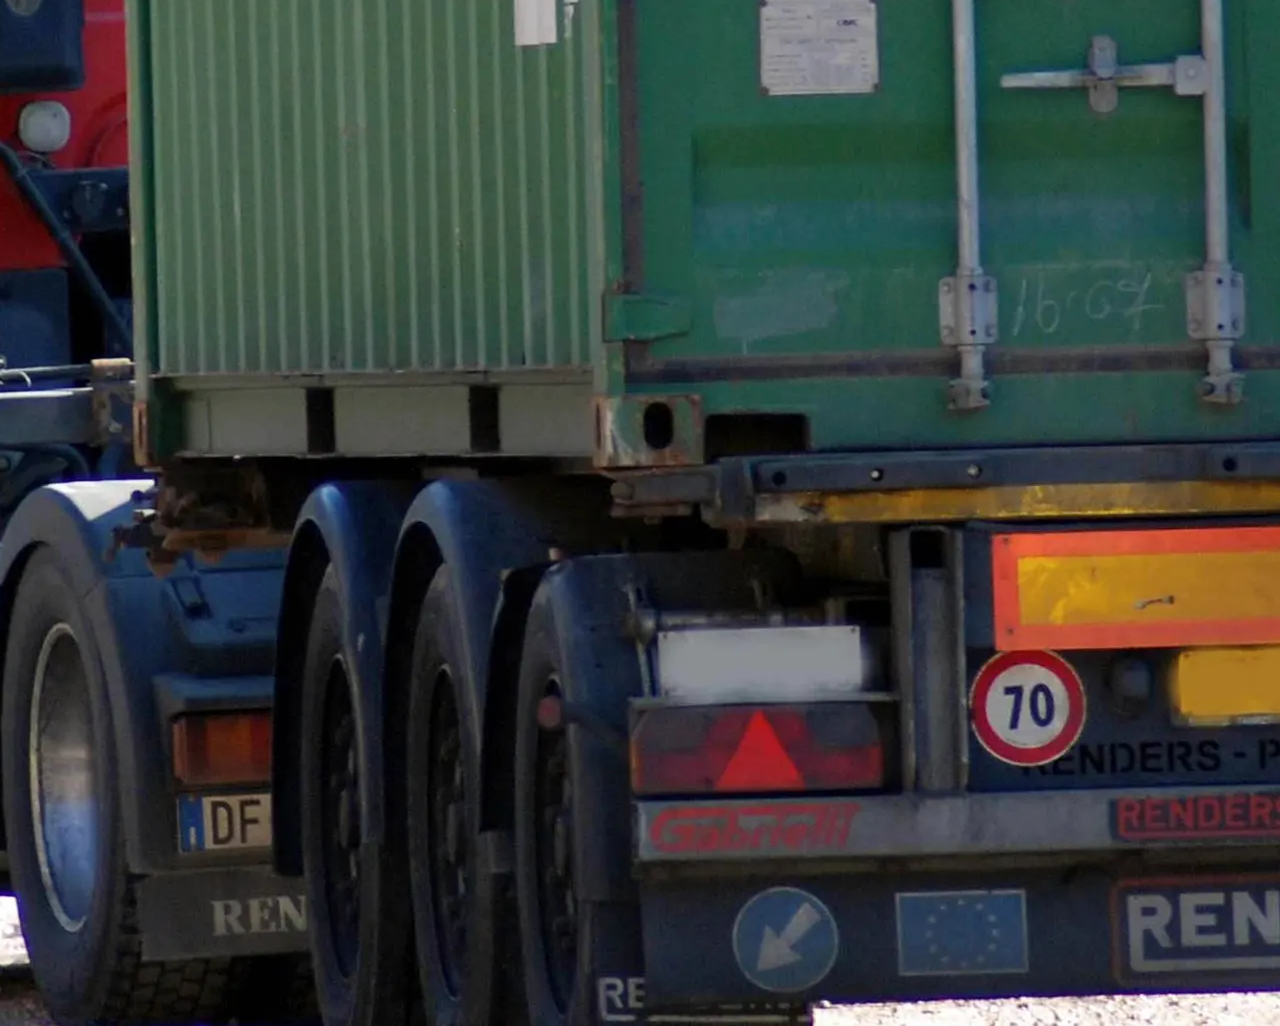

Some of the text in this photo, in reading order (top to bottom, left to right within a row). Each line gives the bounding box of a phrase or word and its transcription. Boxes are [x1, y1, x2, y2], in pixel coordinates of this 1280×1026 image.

[1004, 683, 1055, 730] 70
[1023, 739, 1220, 776] ENDERS
[210, 799, 261, 845] DF
[211, 895, 307, 936] REN
